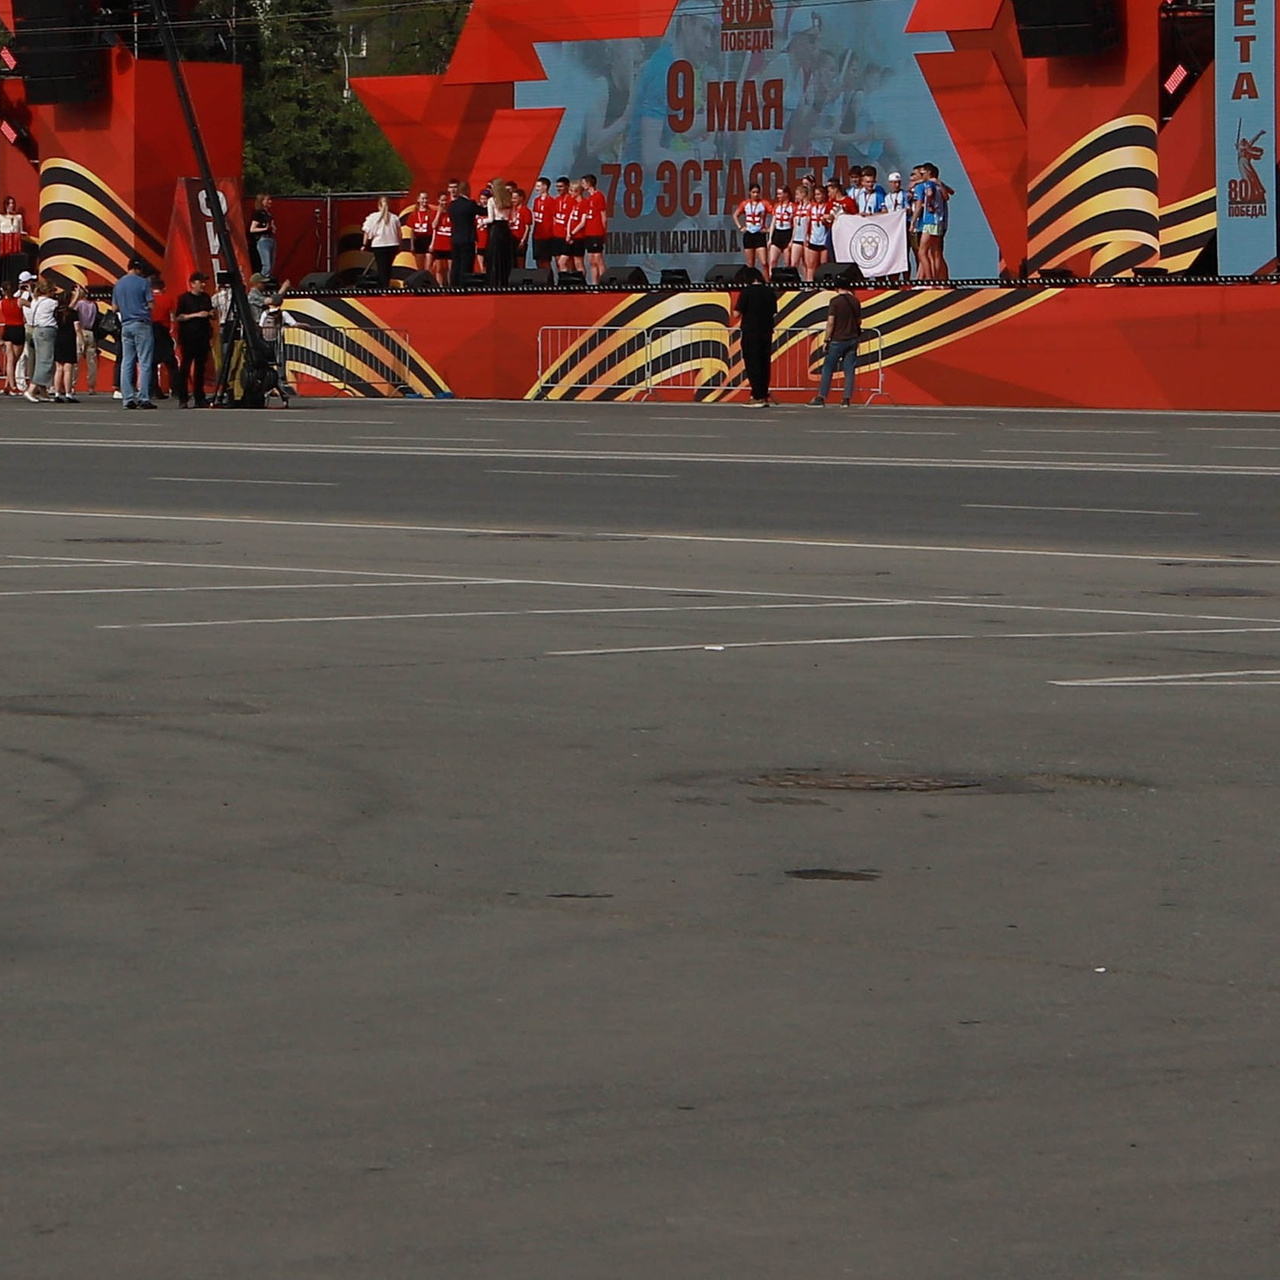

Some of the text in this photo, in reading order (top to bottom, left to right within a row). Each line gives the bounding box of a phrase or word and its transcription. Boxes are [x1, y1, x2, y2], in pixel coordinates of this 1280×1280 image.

[721, 30, 774, 53] ПОБЕДА!
[667, 59, 783, 133] 9 МАЯ
[601, 162, 642, 218] 78
[1228, 178, 1250, 202] 80
[1228, 205, 1267, 218] ПОБЕДА!
[606, 232, 657, 254] ПАМЯТИ
[660, 229, 726, 253] МАРШАЛА
